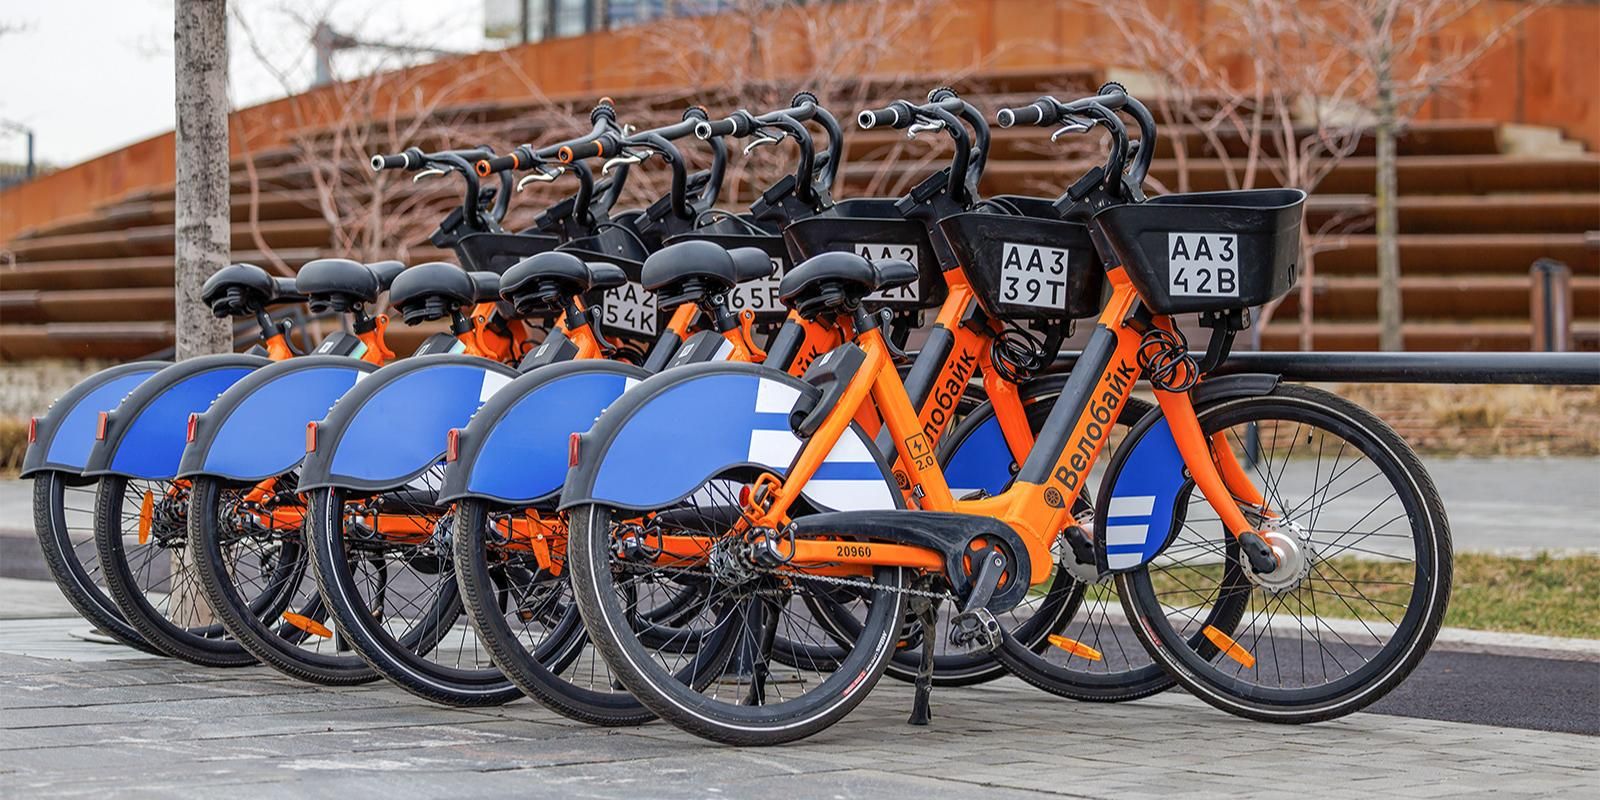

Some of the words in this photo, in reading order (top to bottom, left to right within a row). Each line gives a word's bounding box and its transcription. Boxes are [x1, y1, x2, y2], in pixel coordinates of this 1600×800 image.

[1004, 246, 1064, 275] AA3
[1171, 236, 1234, 262] AA3
[1004, 276, 1065, 305] 39T
[1173, 267, 1236, 294] 42B
[606, 304, 654, 332] 54K
[924, 348, 976, 444] лобайк
[1054, 358, 1136, 491] Велобайк
[916, 455, 934, 471] 2.0
[836, 545, 872, 558] 20960
